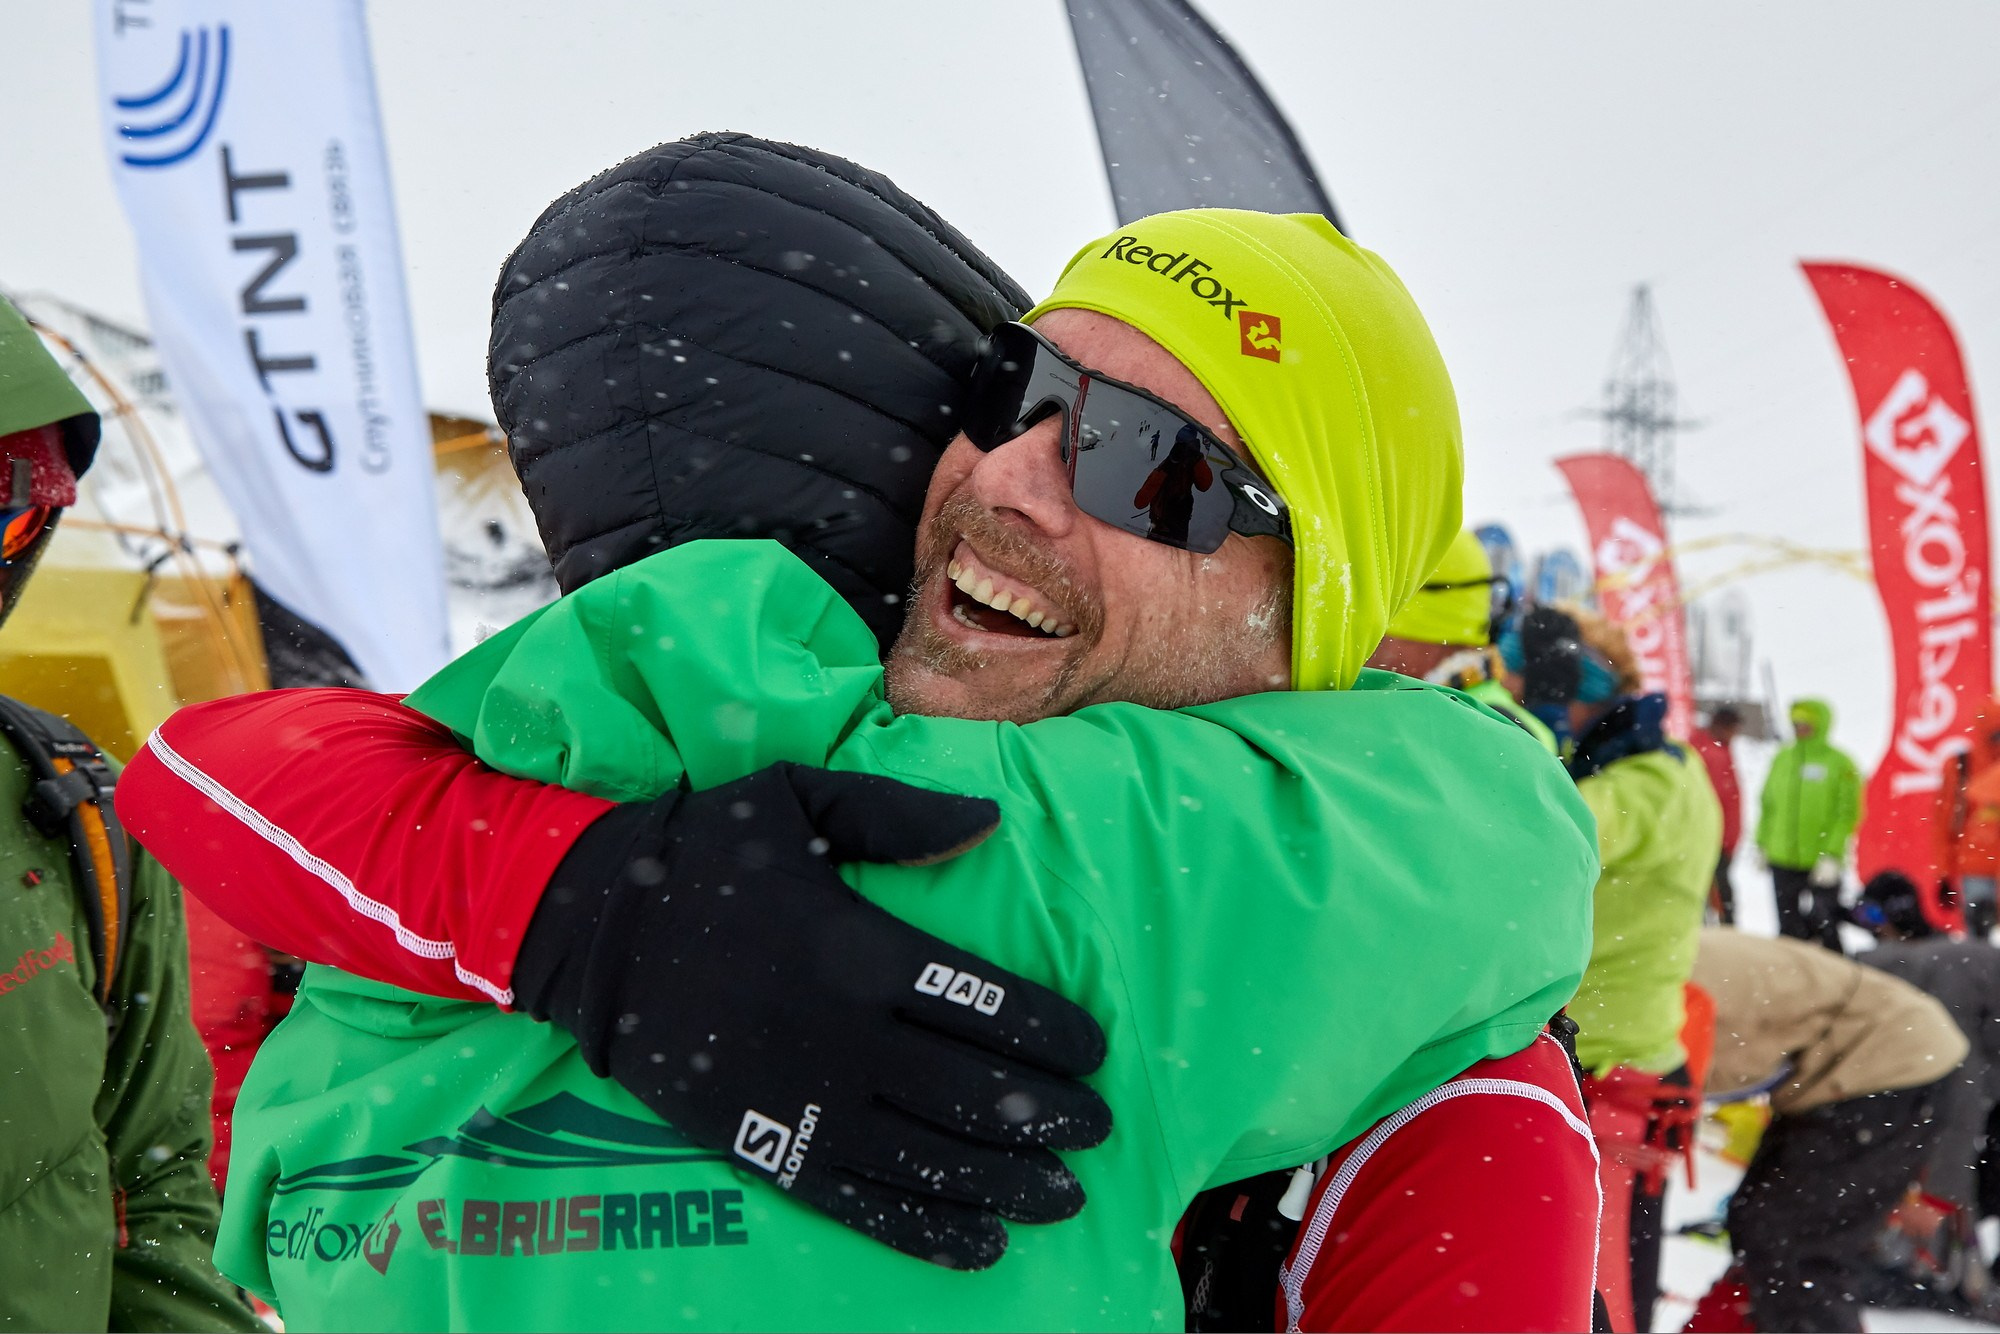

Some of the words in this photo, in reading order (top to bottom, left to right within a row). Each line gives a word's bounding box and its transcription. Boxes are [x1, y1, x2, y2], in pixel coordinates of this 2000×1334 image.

[219, 142, 334, 475] GTNT
[1100, 235, 1249, 321] RedFox
[922, 967, 1000, 1010] LAB
[777, 1103, 821, 1190] alomon
[267, 1206, 374, 1262] edFox
